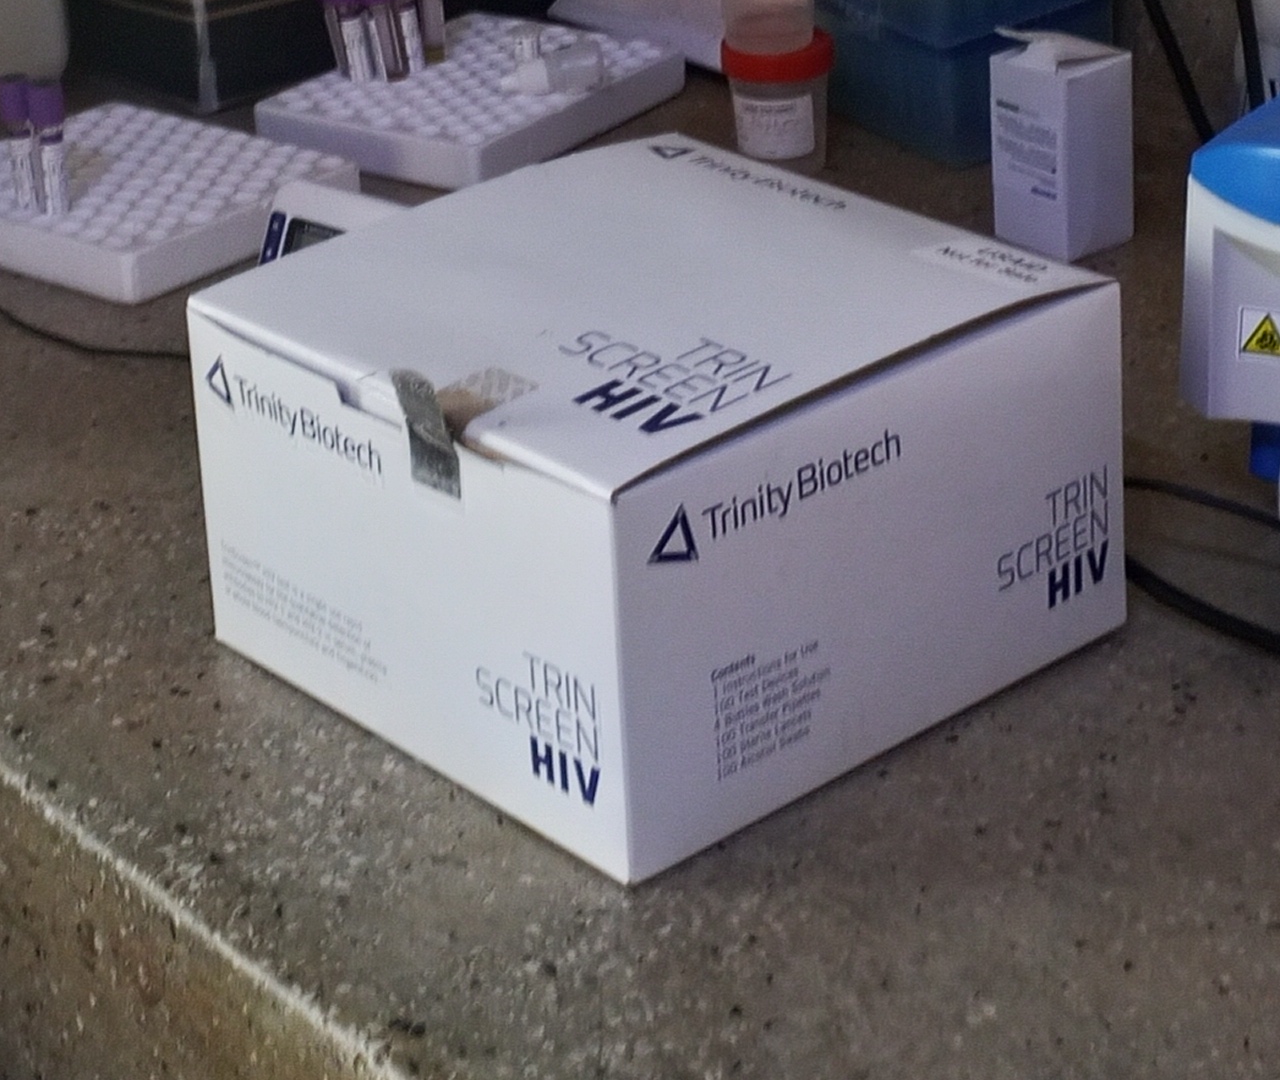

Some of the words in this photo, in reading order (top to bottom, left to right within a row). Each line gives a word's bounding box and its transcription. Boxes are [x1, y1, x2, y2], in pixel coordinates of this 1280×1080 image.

[558, 330, 749, 414] SCREEN
[676, 336, 793, 393] TRIN
[233, 373, 298, 436] Trinity
[300, 407, 382, 475] Biotech
[572, 378, 706, 434] HIV
[701, 481, 793, 540] Trinity
[796, 428, 902, 501] Biotech
[1045, 464, 1108, 527] TRIN
[998, 499, 1109, 592] SCREEN
[1048, 537, 1109, 610] HIV
[476, 665, 599, 763] SCREEN
[522, 650, 597, 723] TRIN
[529, 734, 601, 808] HIV
